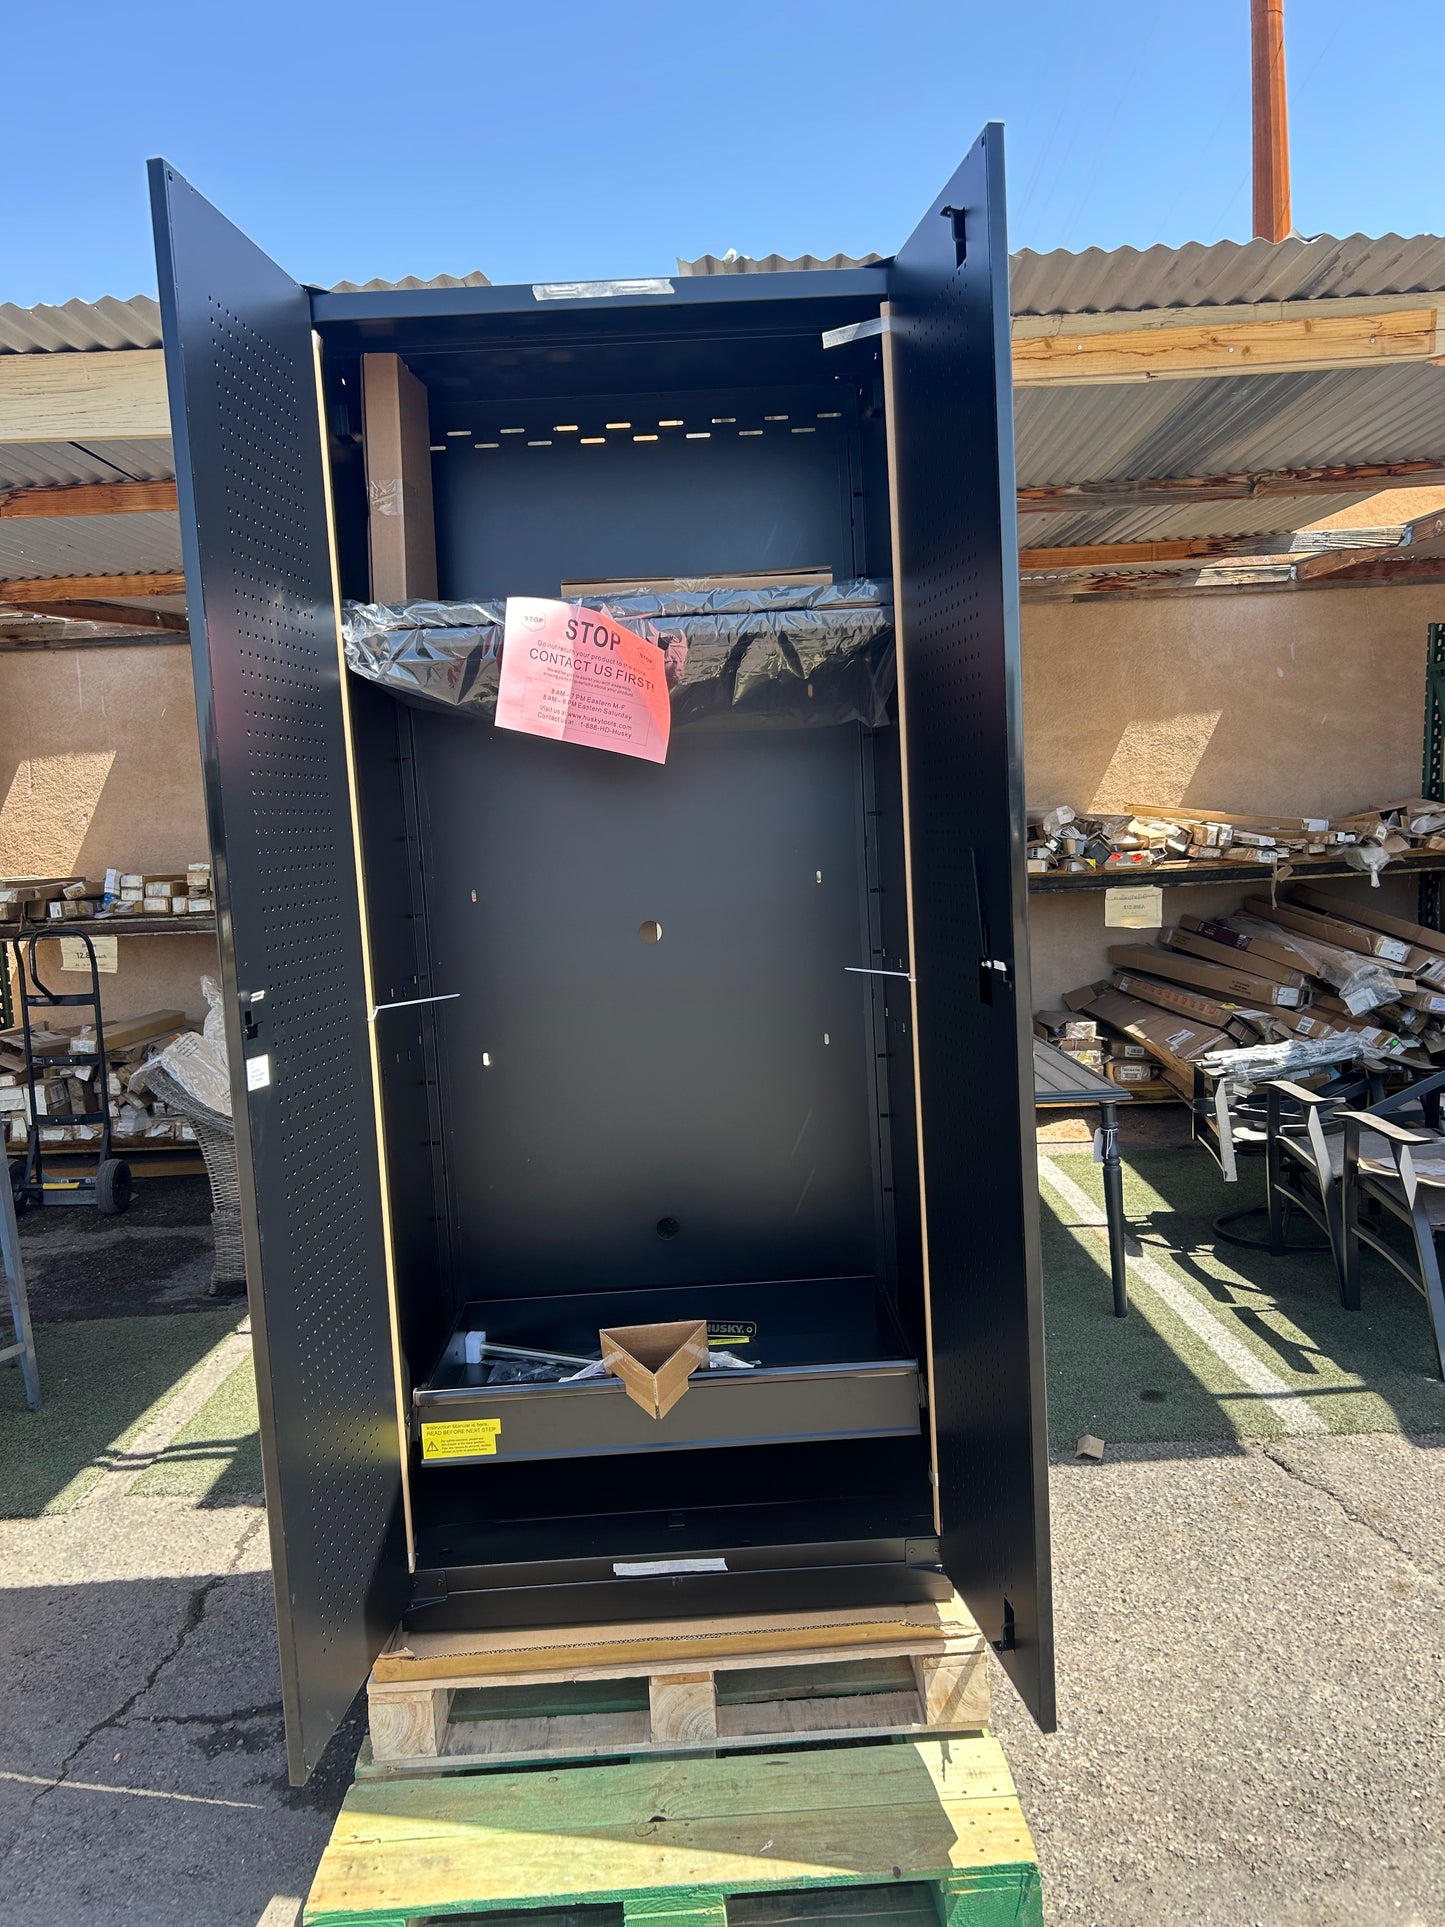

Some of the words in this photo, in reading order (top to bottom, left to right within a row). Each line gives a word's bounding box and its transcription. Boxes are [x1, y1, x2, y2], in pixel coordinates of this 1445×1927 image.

[524, 615, 544, 623] STOP
[566, 619, 621, 651] STOP
[537, 640, 546, 648] Do
[557, 645, 575, 655] return
[576, 650, 590, 659] your
[591, 653, 615, 664] product
[616, 659, 623, 667] to
[639, 653, 653, 664] STOP
[529, 648, 591, 672] CONTACT
[594, 663, 613, 678] US
[615, 669, 655, 693] FIRST!
[540, 704, 553, 712] Visit
[547, 695, 557, 703] AM
[567, 699, 577, 707] PM
[577, 702, 602, 713] Eastern
[603, 707, 632, 721] Saturday
[575, 693, 586, 701] PM
[586, 696, 612, 707] Eastern
[613, 702, 626, 710] M-F
[537, 711, 560, 722] Contact
[580, 721, 633, 739] 1-888-HD-Husky
